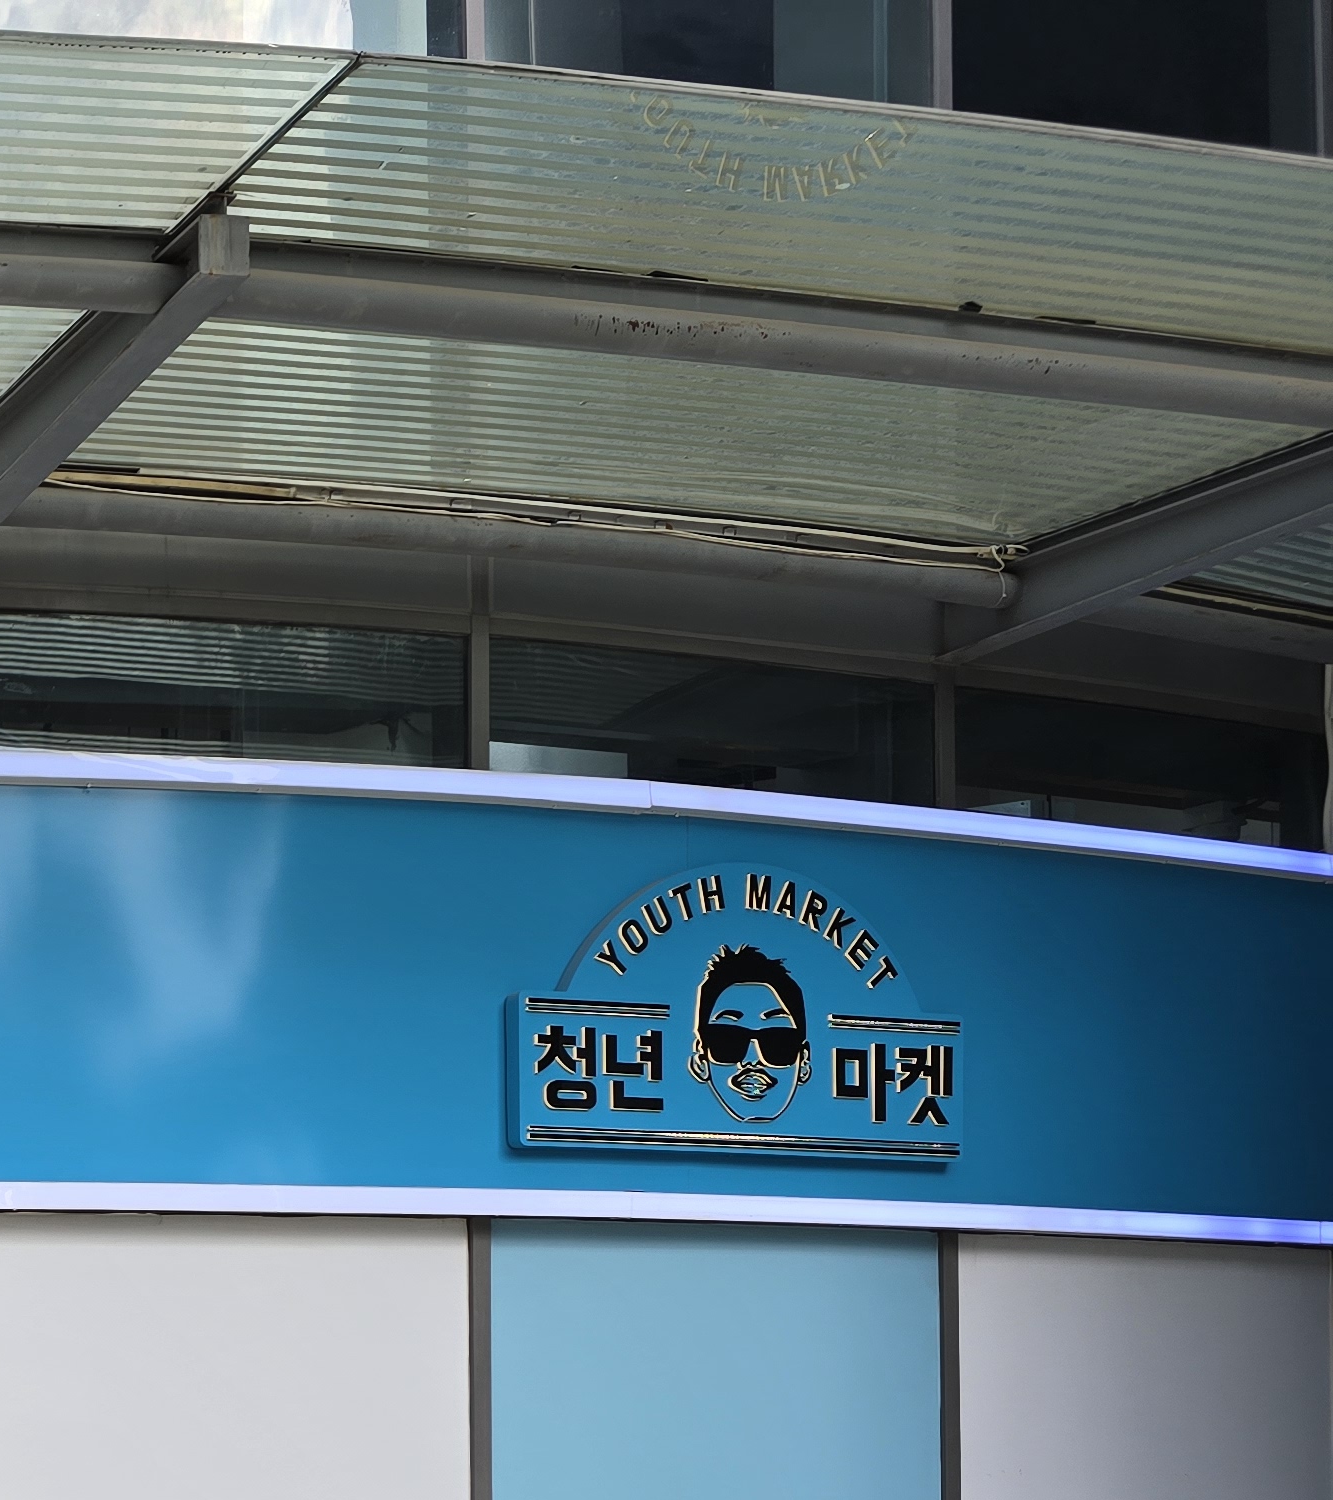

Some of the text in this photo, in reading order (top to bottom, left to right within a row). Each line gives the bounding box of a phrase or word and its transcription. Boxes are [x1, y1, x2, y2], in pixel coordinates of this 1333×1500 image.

[594, 873, 899, 990] YOUTH MARKET
[534, 1024, 954, 1126] 청년 마켓
